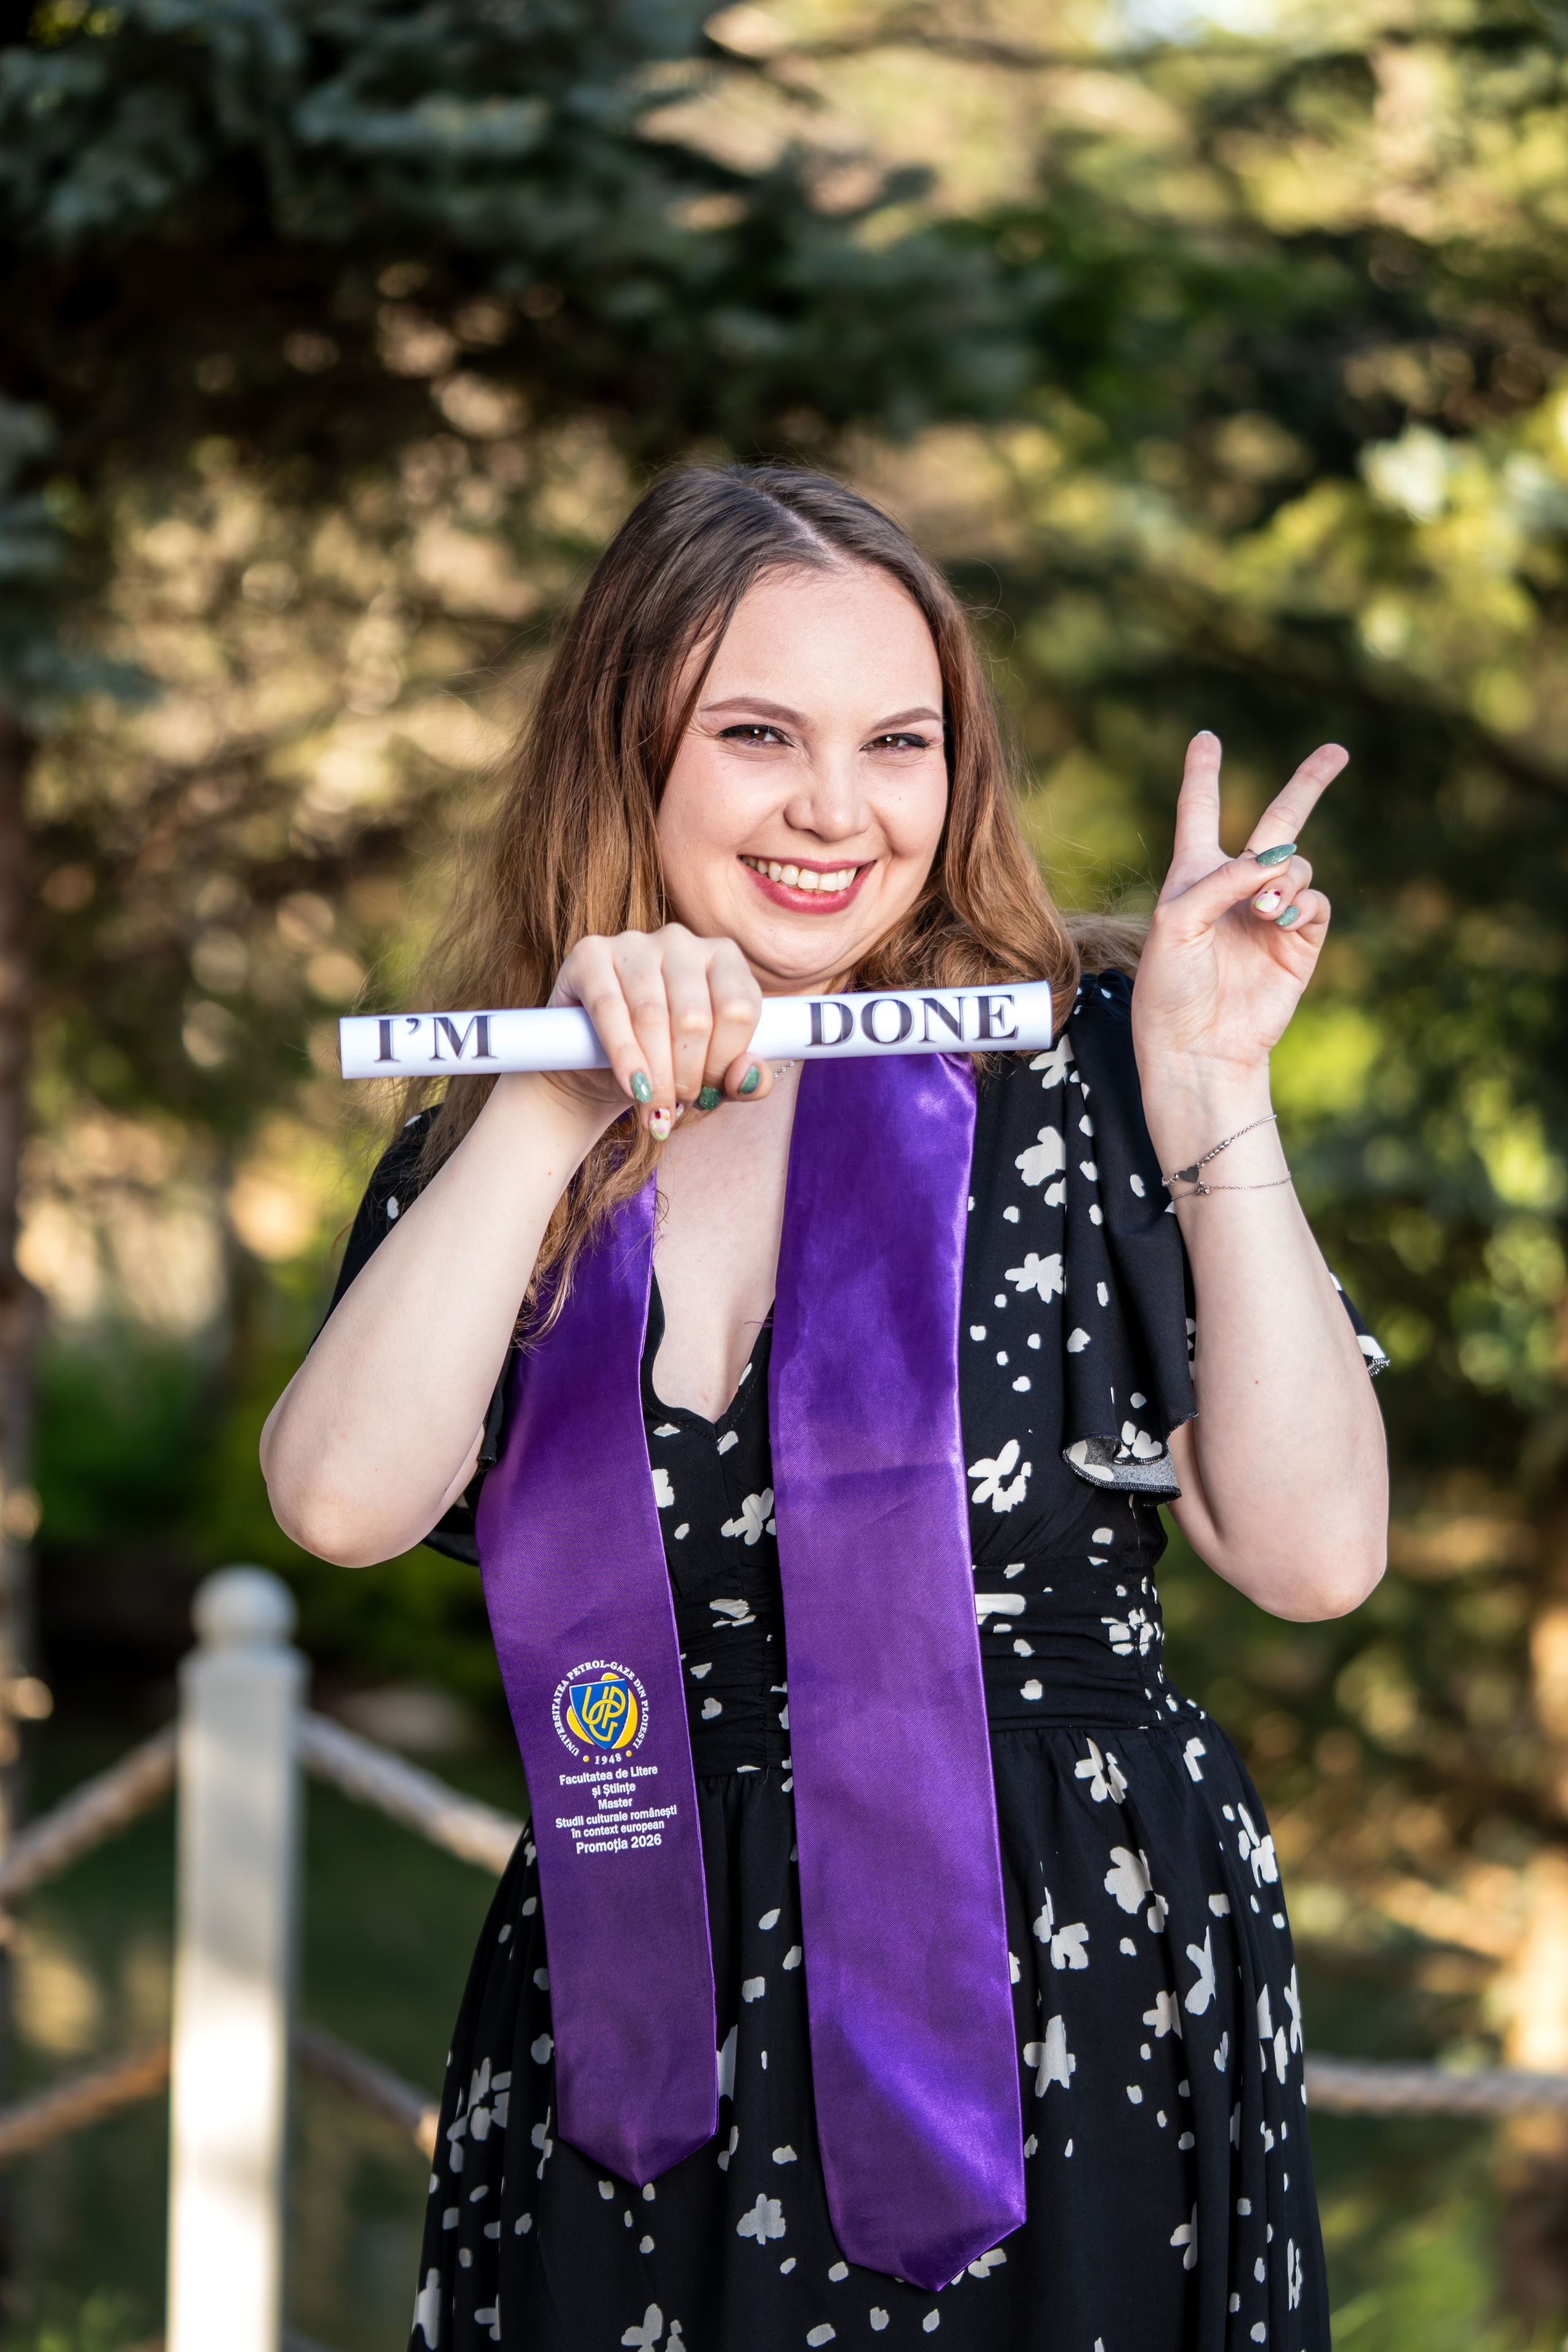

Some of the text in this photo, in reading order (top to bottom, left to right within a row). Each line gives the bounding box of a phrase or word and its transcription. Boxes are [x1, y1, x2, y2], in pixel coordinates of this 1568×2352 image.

[804, 995, 1019, 1047] DONE
[552, 1680, 579, 1757] UNIVERSITATEA
[567, 1660, 635, 1681] PETROL-GAZE
[633, 1678, 646, 1698] DIN
[595, 1753, 622, 1765] 1948
[559, 1766, 658, 1785] Facultatea de Litere
[592, 1782, 636, 1798] și Științe
[598, 1798, 633, 1810] Master
[556, 1804, 677, 1828] Studii culturale românești
[570, 1820, 665, 1839] în context european
[576, 1833, 662, 1854] Promoția 2026
